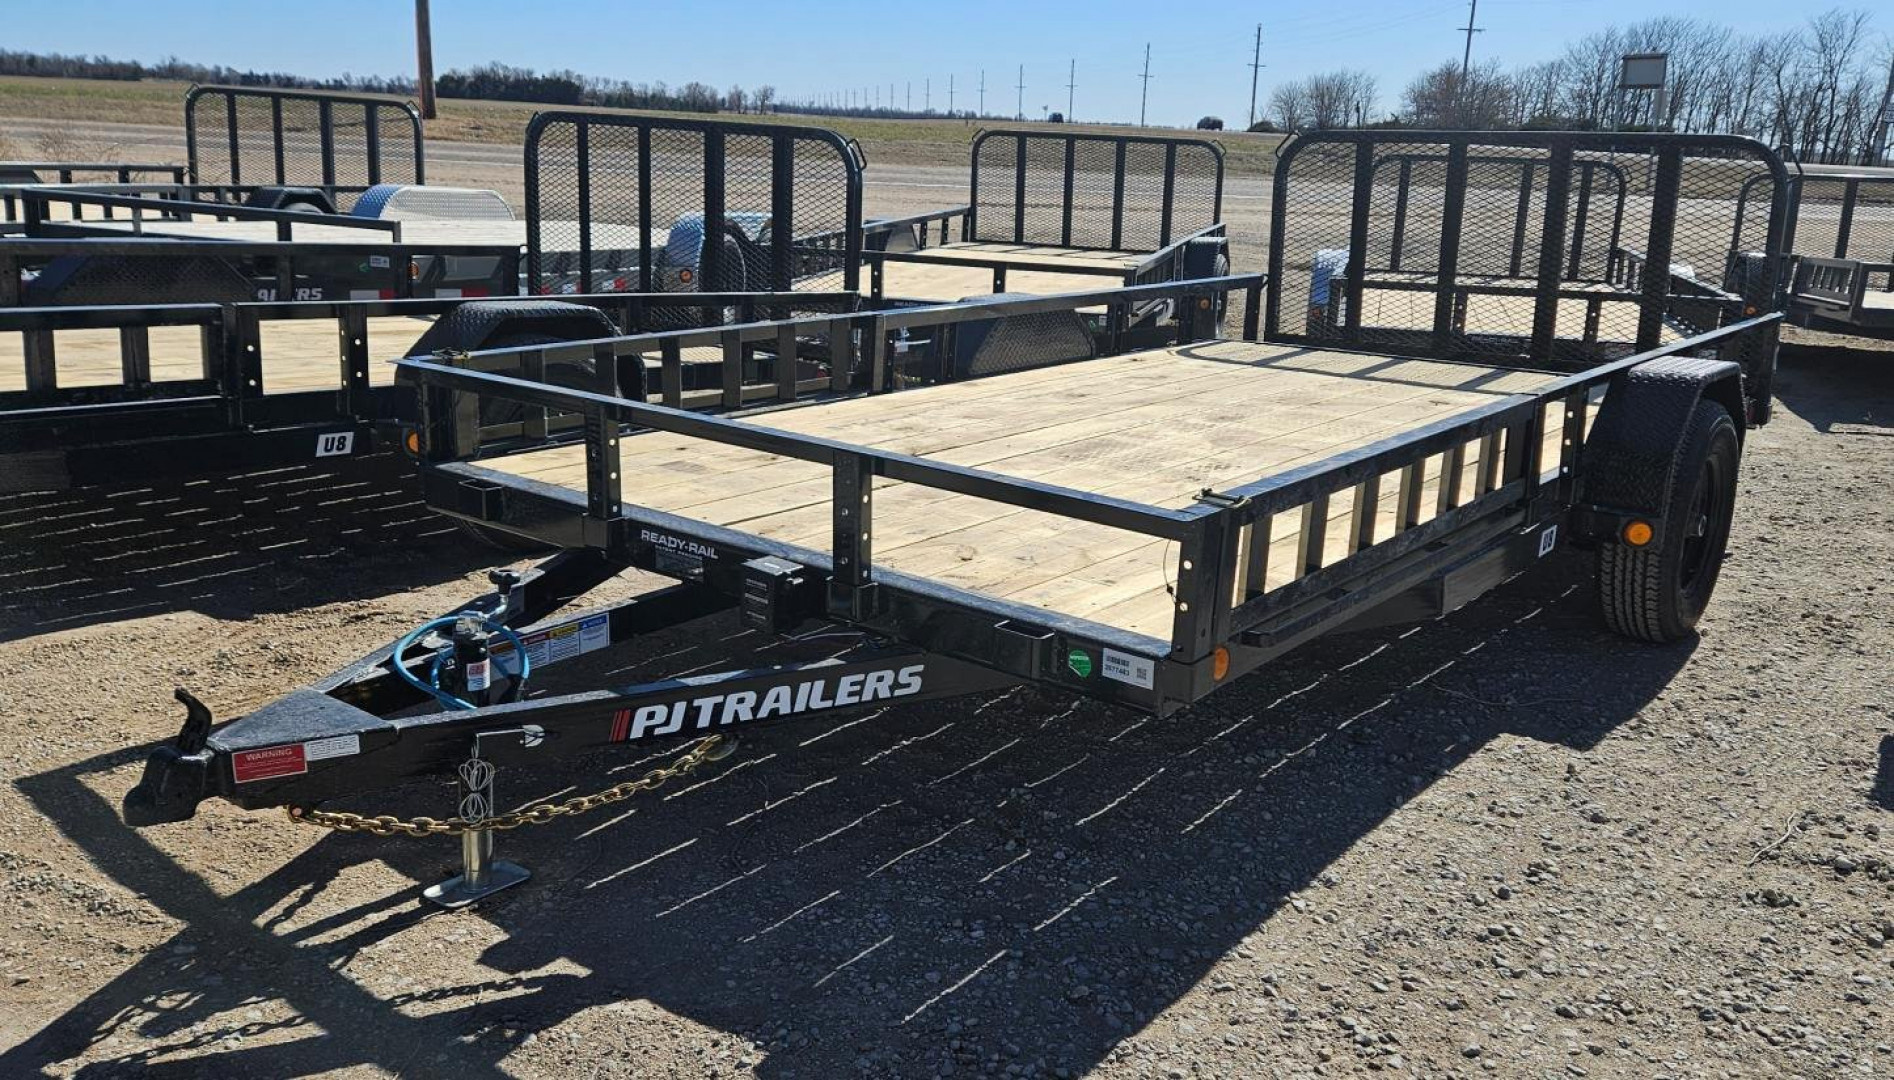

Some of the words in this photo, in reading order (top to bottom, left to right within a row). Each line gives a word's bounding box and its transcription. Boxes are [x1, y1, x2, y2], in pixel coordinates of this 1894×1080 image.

[323, 436, 347, 453] U8
[641, 529, 719, 559] READY-RAIL
[629, 701, 688, 739] PJ
[692, 664, 925, 729] TRAILERS
[245, 747, 293, 762] WARNING
